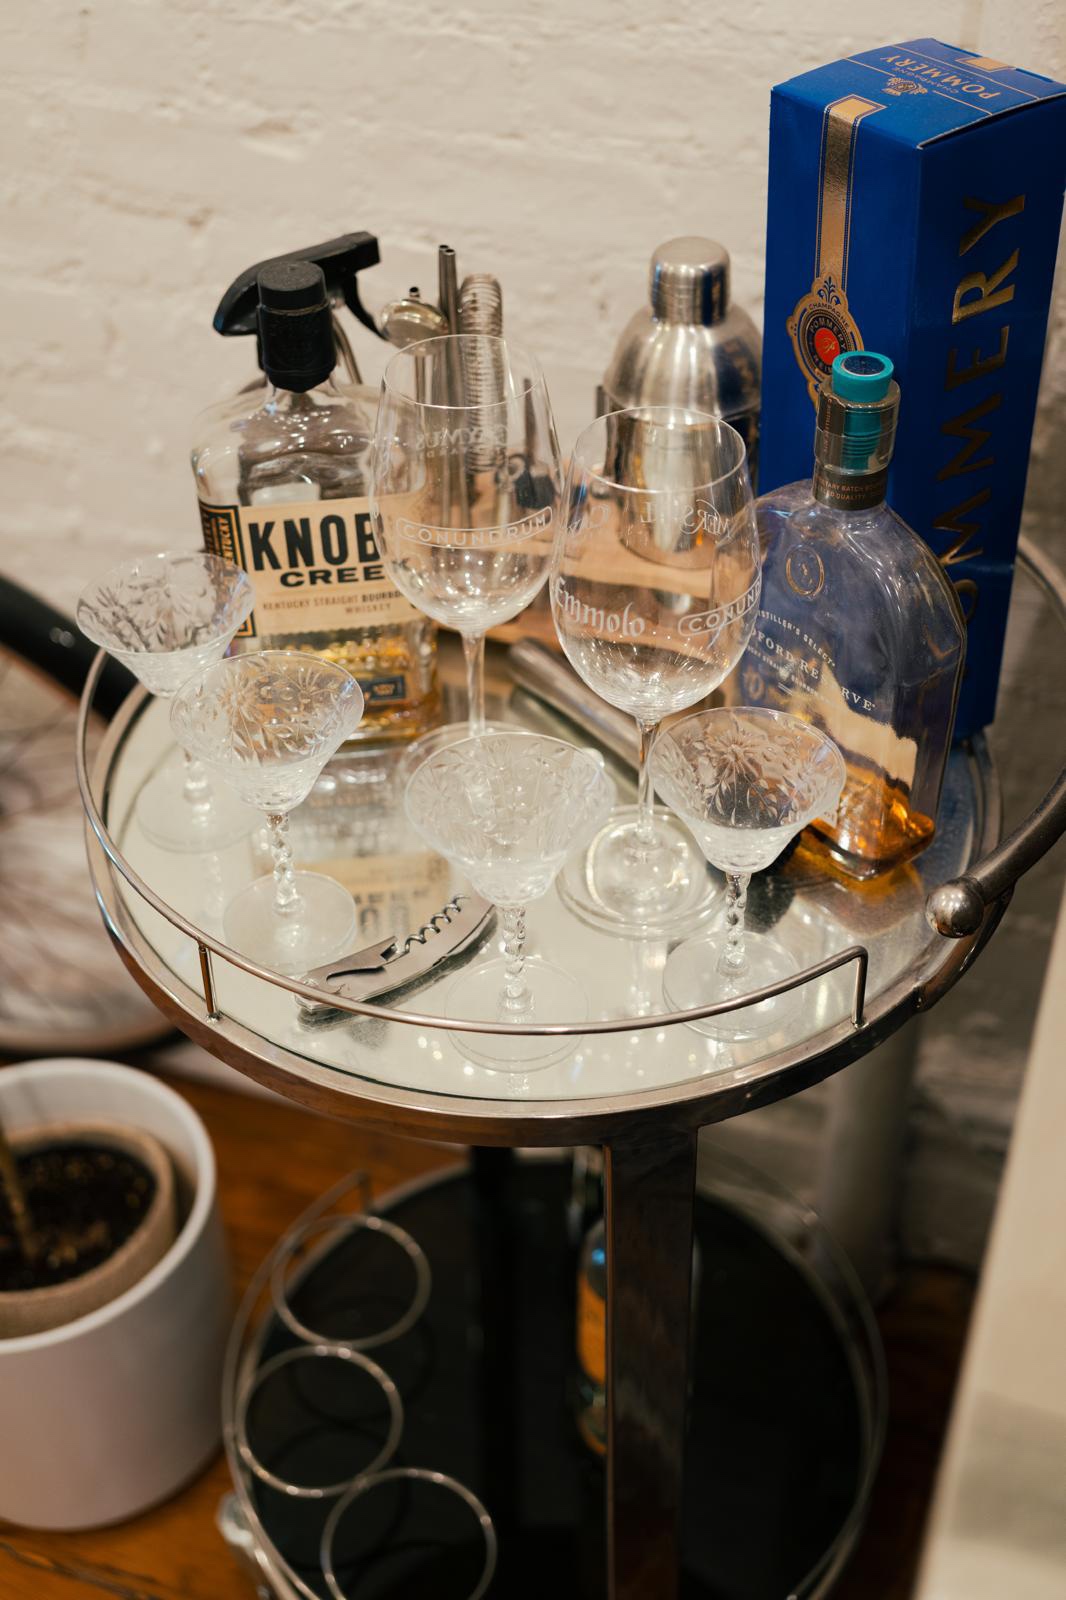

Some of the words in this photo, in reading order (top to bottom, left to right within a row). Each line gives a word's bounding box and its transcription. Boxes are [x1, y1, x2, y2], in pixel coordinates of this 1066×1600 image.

[880, 53, 1002, 100] POMMERY
[932, 194, 1026, 624] OMMERY
[248, 512, 382, 571] KNOB
[403, 514, 547, 546] CONUNDRUM
[280, 564, 386, 588] CREE
[361, 590, 403, 603] BOURBO
[758, 609, 801, 636] ISTILLER'S
[800, 659, 873, 712] RERVE
